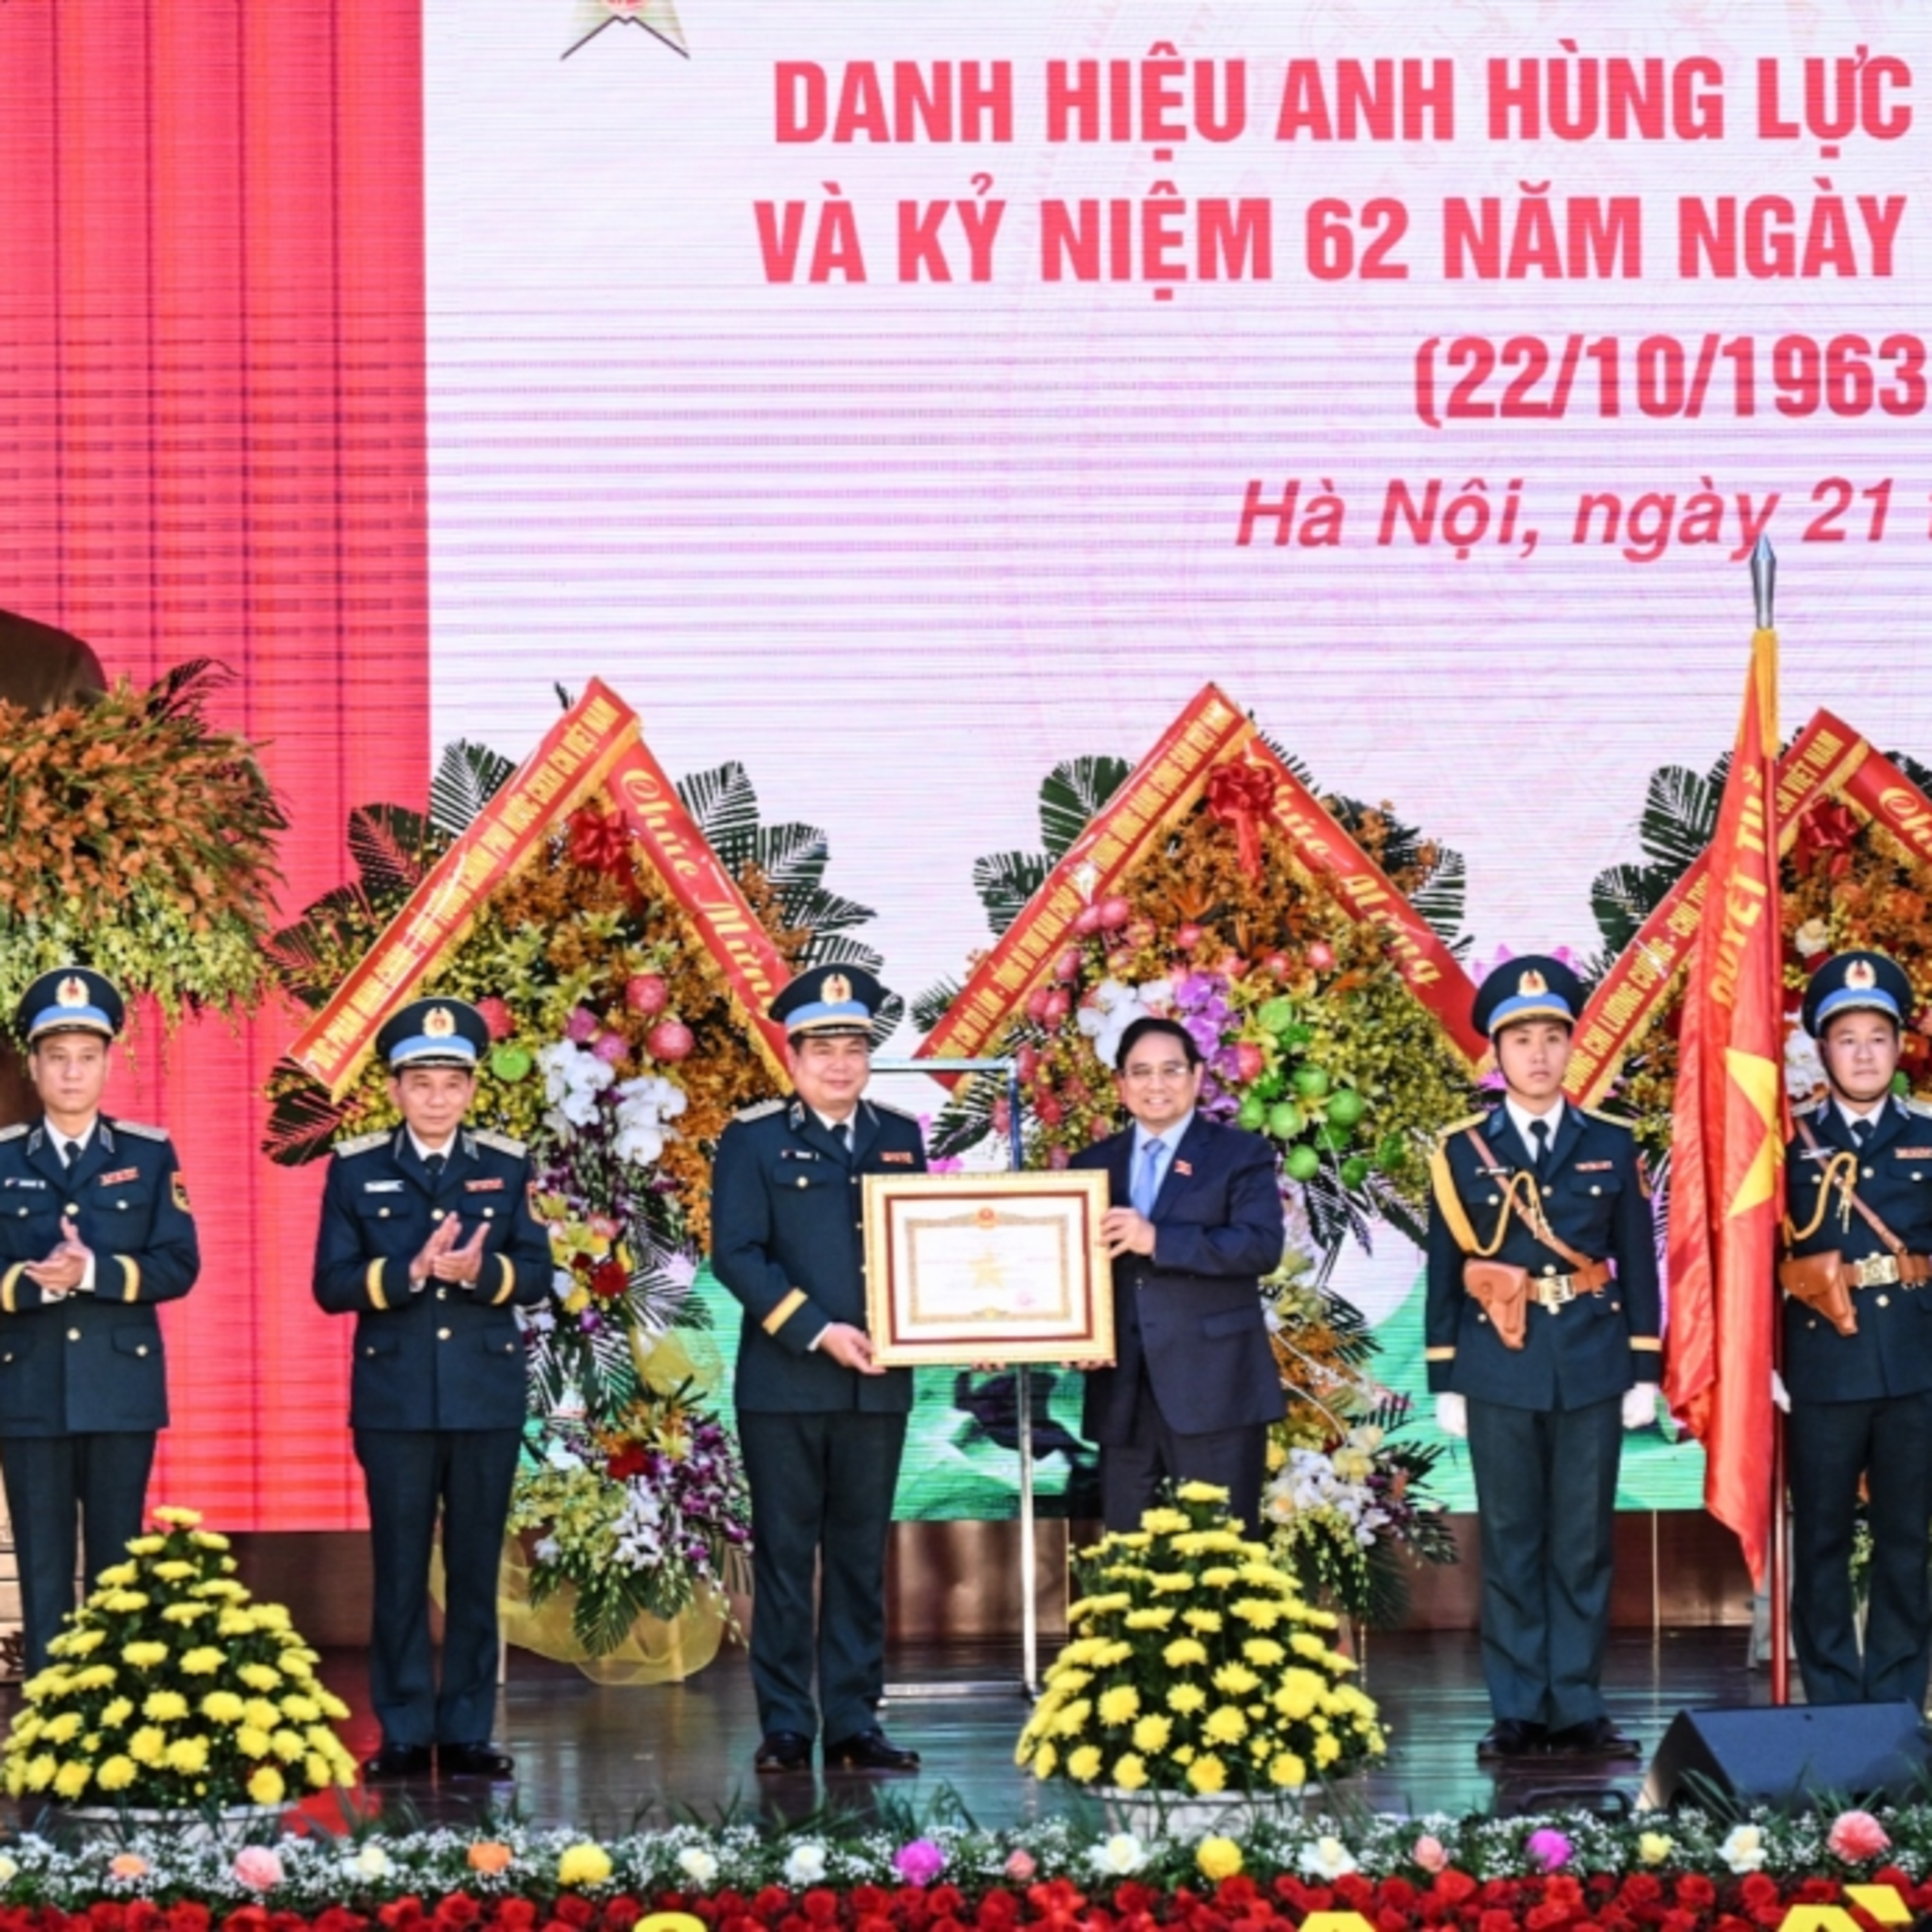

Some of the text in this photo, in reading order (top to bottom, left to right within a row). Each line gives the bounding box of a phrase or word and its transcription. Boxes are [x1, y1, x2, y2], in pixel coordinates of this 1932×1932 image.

[775, 39, 1913, 162] DANH HIỆU ANH HÙNG LỰC
[753, 173, 1907, 301] VÀ KỶ NIỆM 62 NĂM NGÀY
[1414, 333, 1927, 430] (22/10/1963
[1236, 478, 1346, 547] Hà
[1376, 478, 1539, 560] Nội,
[1571, 477, 1781, 564] ngày
[1802, 477, 1893, 543] 21
[621, 768, 699, 880] Chúc
[1879, 786, 1932, 857] Ch
